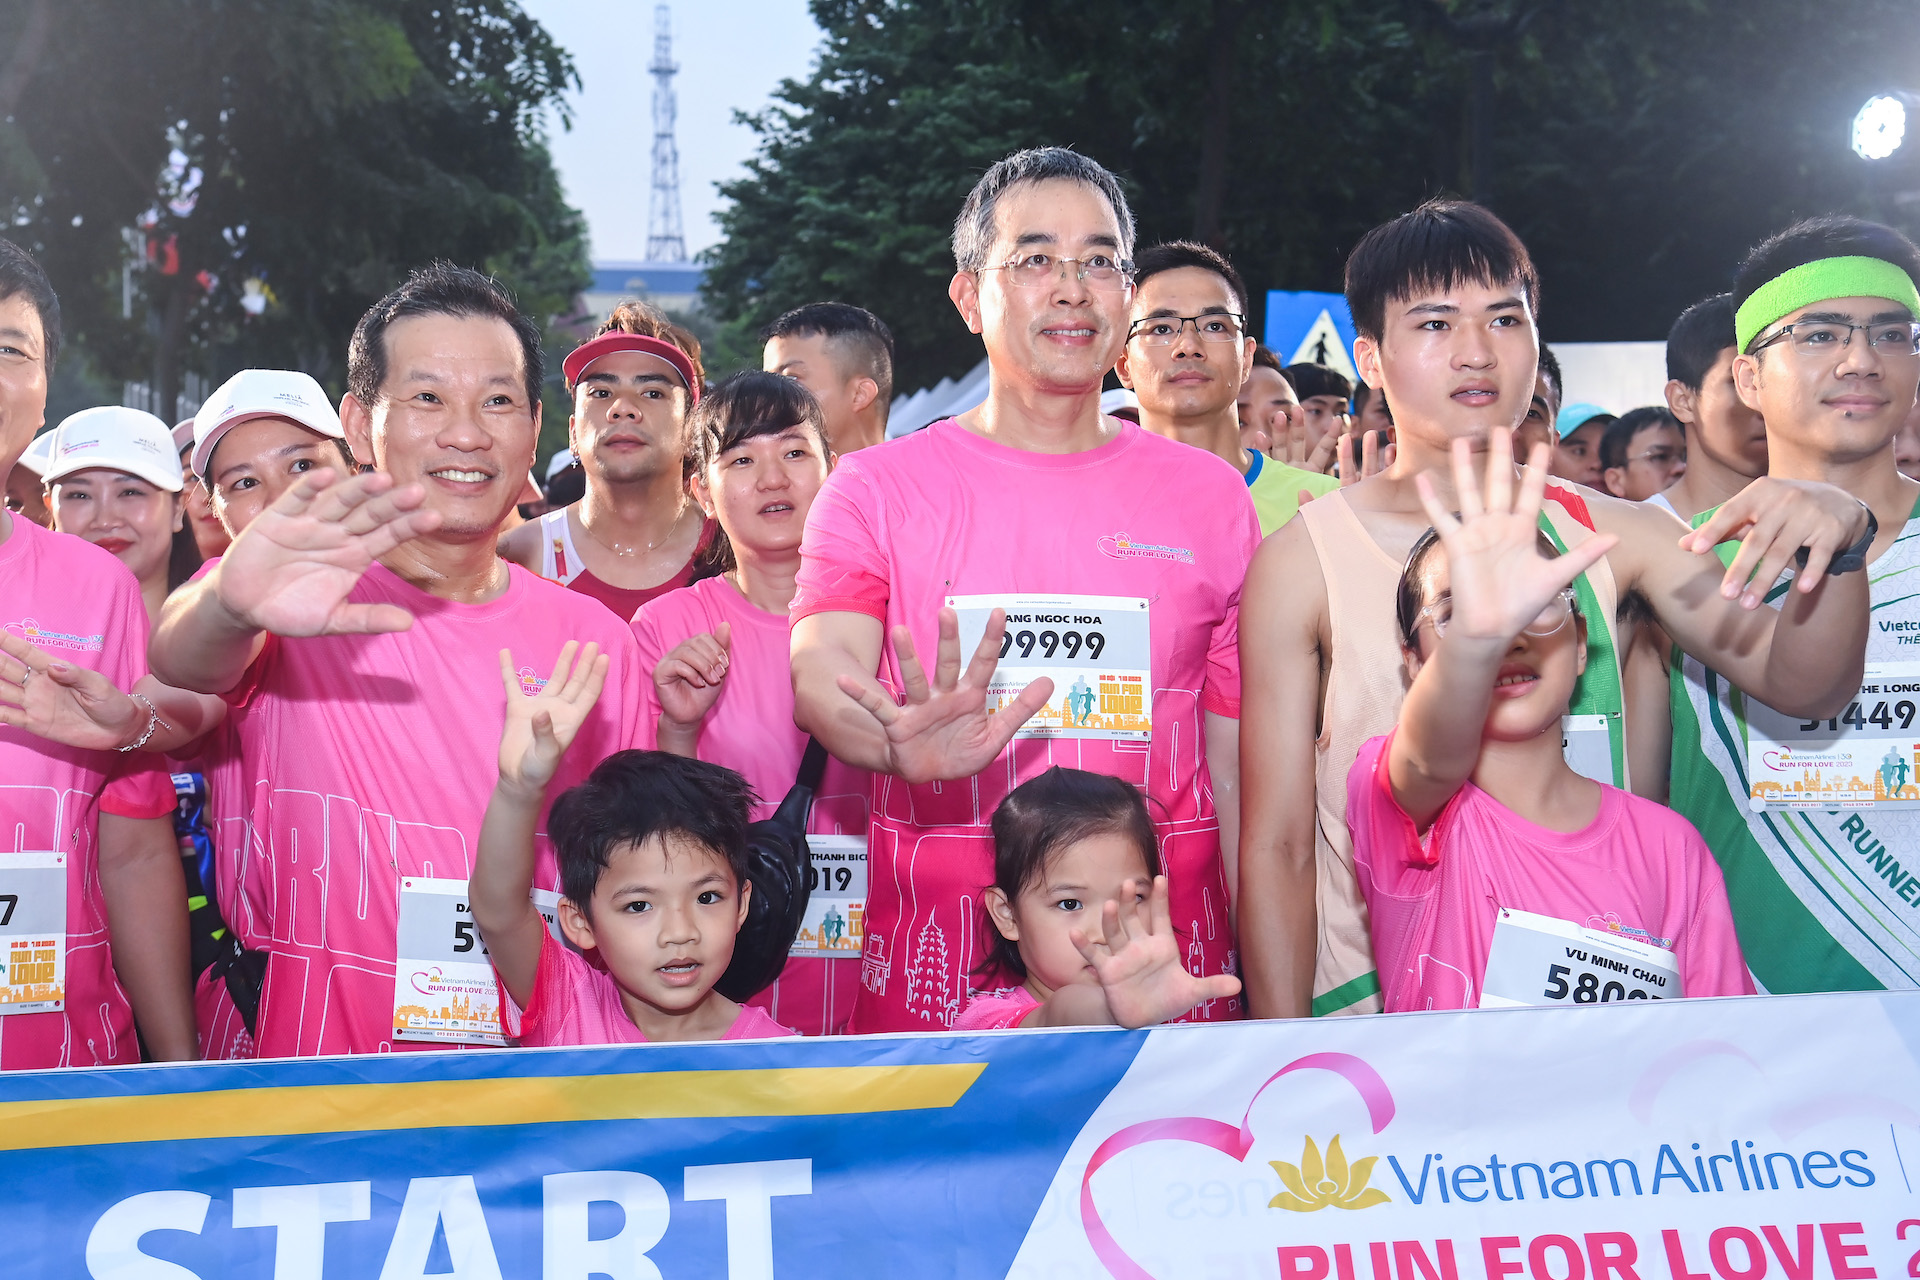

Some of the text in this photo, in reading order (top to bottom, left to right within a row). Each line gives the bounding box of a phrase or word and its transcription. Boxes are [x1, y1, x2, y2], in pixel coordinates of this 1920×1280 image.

[1129, 542, 1155, 551] Vietnam
[1004, 614, 1102, 625] ANG NGOC HOA
[1878, 619, 1920, 633] Vietc
[26, 637, 46, 645] RUN
[48, 640, 64, 648] FOR
[65, 642, 87, 651] LOVE
[534, 678, 548, 686] Viet
[524, 685, 541, 693] RUN
[1099, 683, 1142, 695] RUN FOR
[1861, 684, 1920, 694] HE LONG
[1790, 753, 1814, 761] Vietnam
[1814, 753, 1836, 761] Airlines
[1836, 760, 1853, 768] 2023
[810, 853, 846, 862] THANH
[1838, 811, 1920, 909] RUNNE
[10, 949, 56, 964] RUN FOR
[1565, 946, 1667, 987] VU MINH CHAU
[441, 976, 466, 985] Vietnam
[1544, 963, 1665, 1004] 580
[428, 984, 446, 993] RUN
[447, 985, 463, 993] FOR
[484, 988, 499, 996] 2023
[1387, 1138, 1877, 1205] Vietnam Airlines
[86, 1158, 813, 1280] START
[1277, 1238, 1456, 1280] RUN
[1480, 1231, 1643, 1280] FOR
[1661, 1222, 1878, 1280] LOVE
